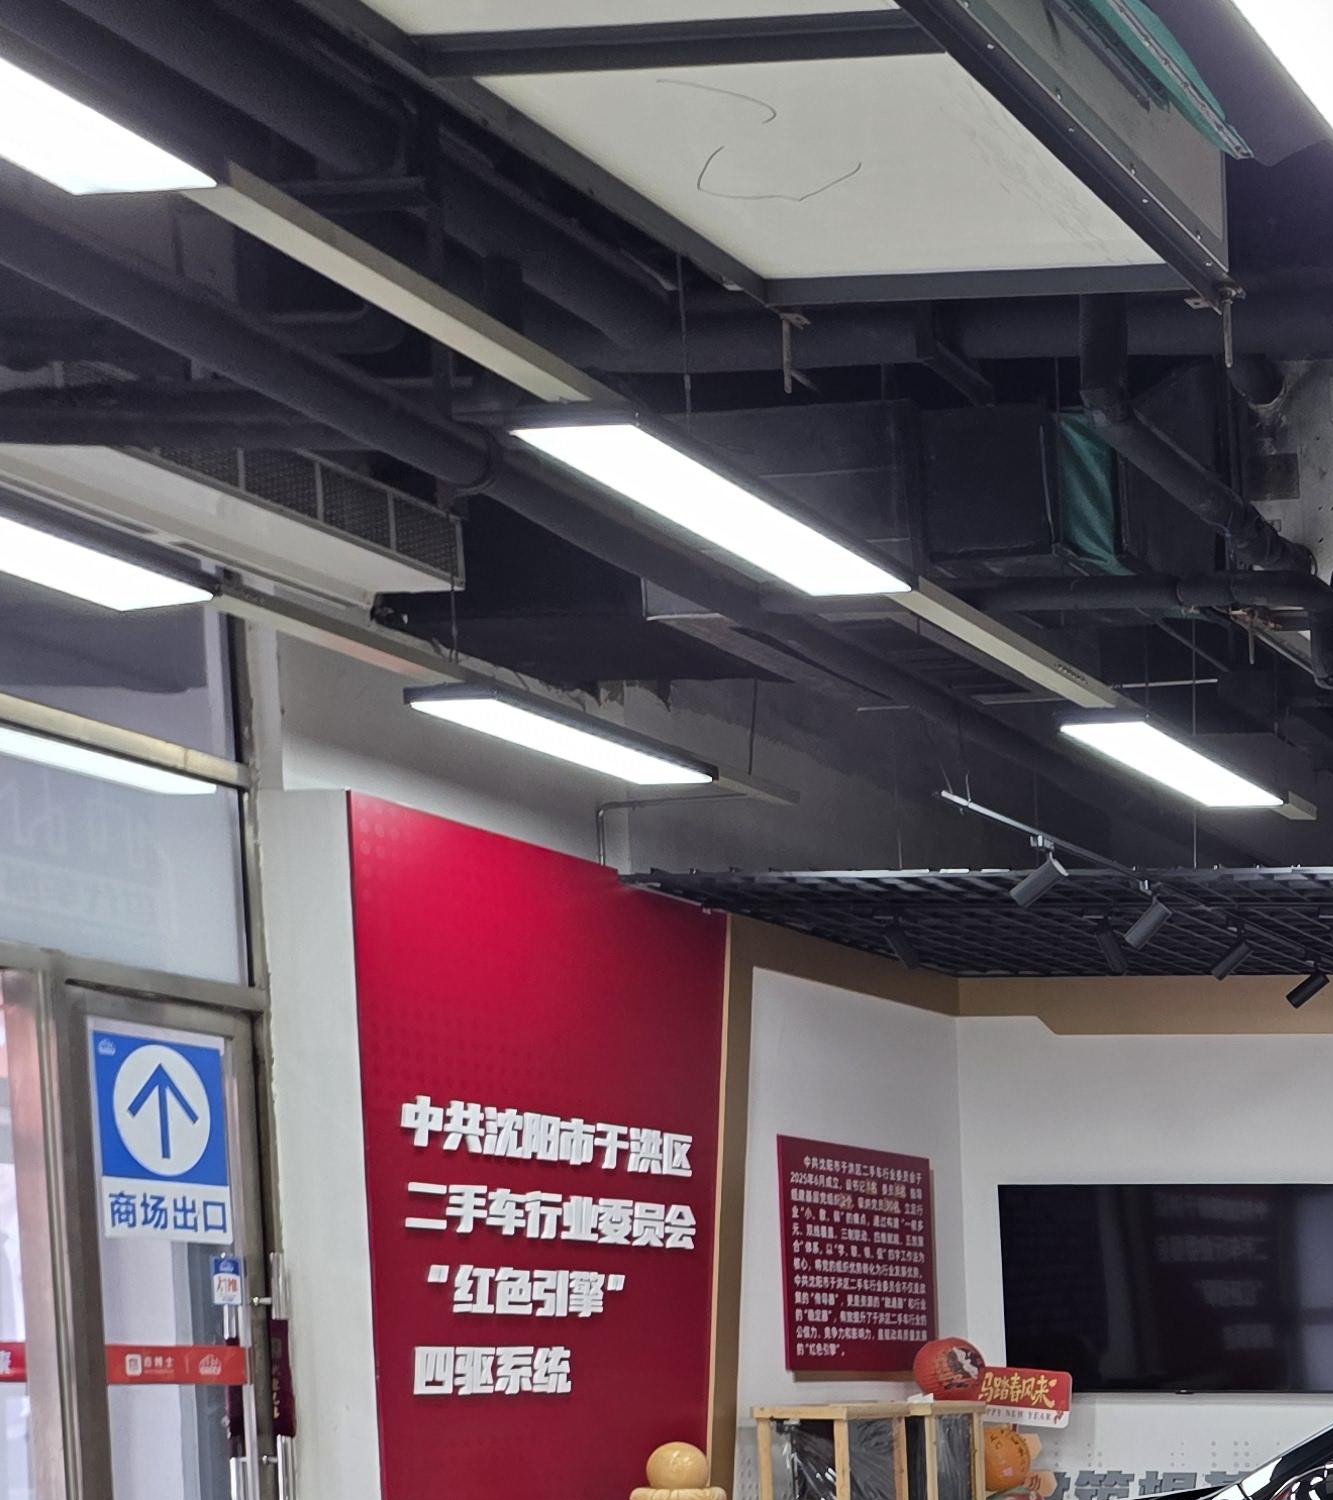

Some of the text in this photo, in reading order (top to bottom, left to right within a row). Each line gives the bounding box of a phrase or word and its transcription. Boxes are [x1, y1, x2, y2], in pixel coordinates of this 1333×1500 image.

[400, 1095, 693, 1177] 中共沈阳市于洪区
[109, 1191, 227, 1233] 商场出口
[404, 1181, 696, 1250] 二手车行业委员会
[427, 1264, 625, 1318] “红色引擎”
[413, 1346, 571, 1395] 四驱系统
